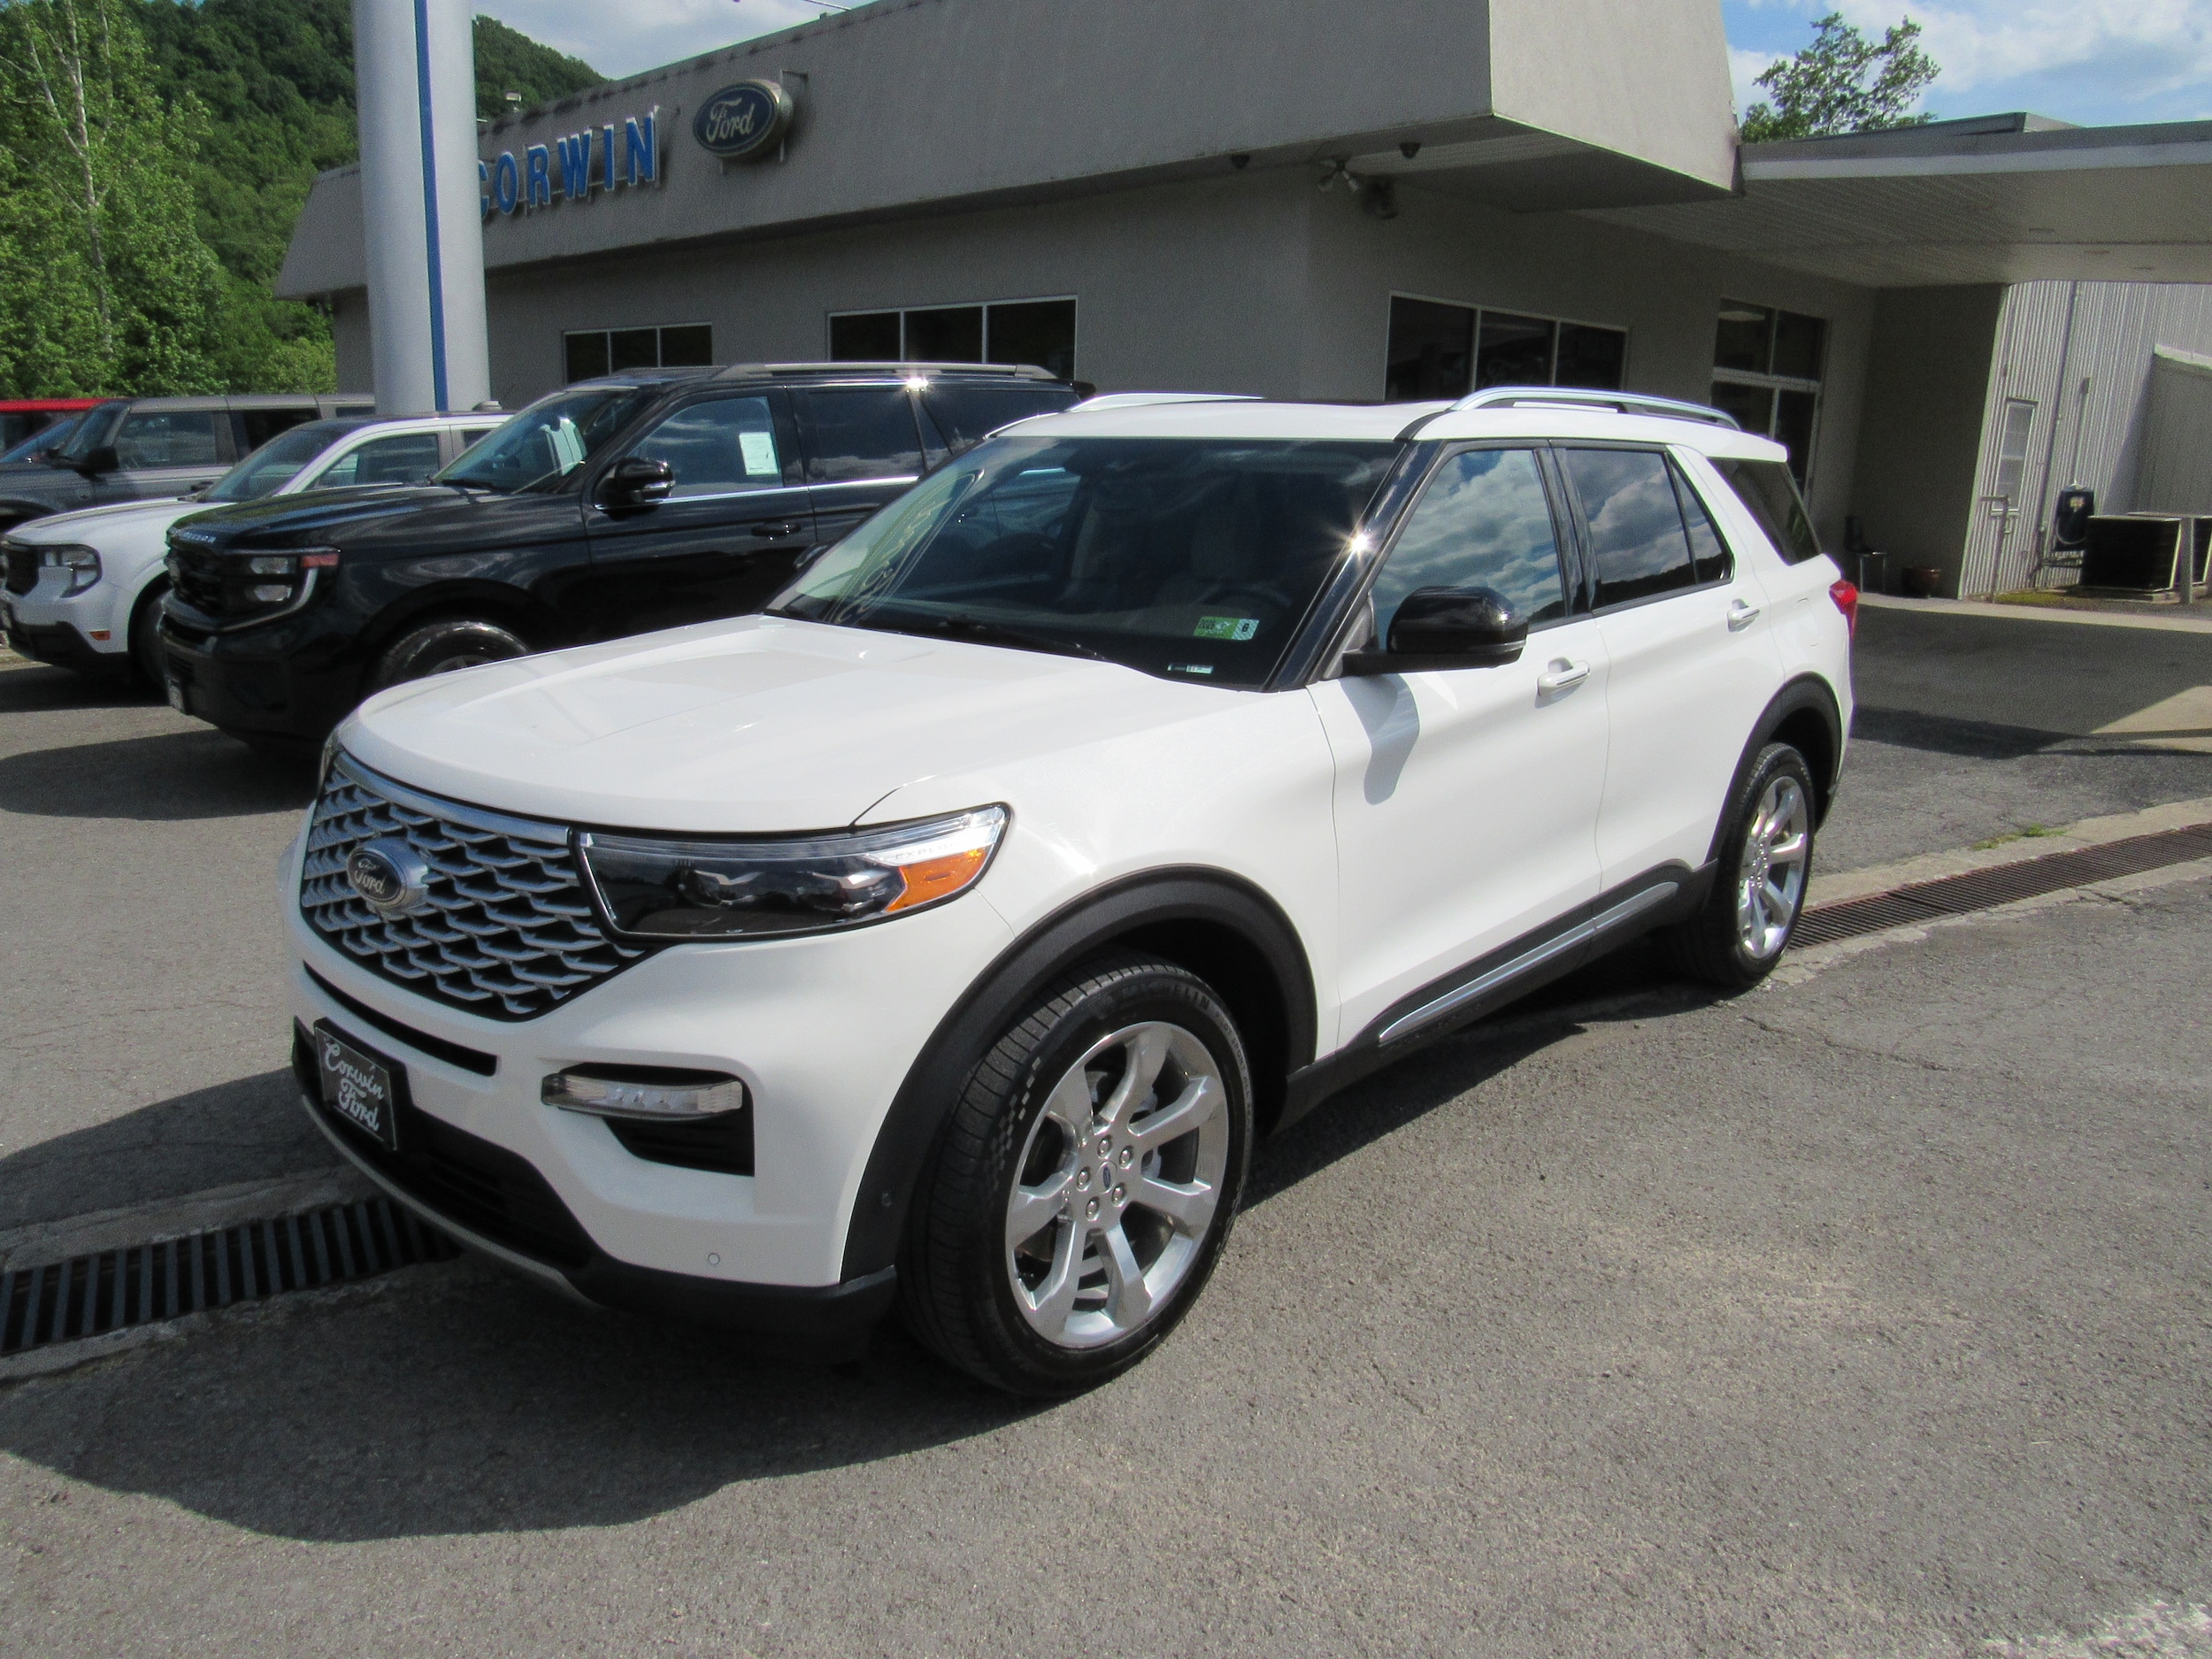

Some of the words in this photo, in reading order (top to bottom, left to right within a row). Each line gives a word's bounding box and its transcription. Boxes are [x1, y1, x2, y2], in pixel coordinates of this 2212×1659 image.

[706, 97, 756, 142] Ford
[895, 841, 959, 860] EXPLO
[355, 857, 388, 895] Ford
[324, 1041, 385, 1100] Corwin
[338, 1078, 380, 1132] Ford
